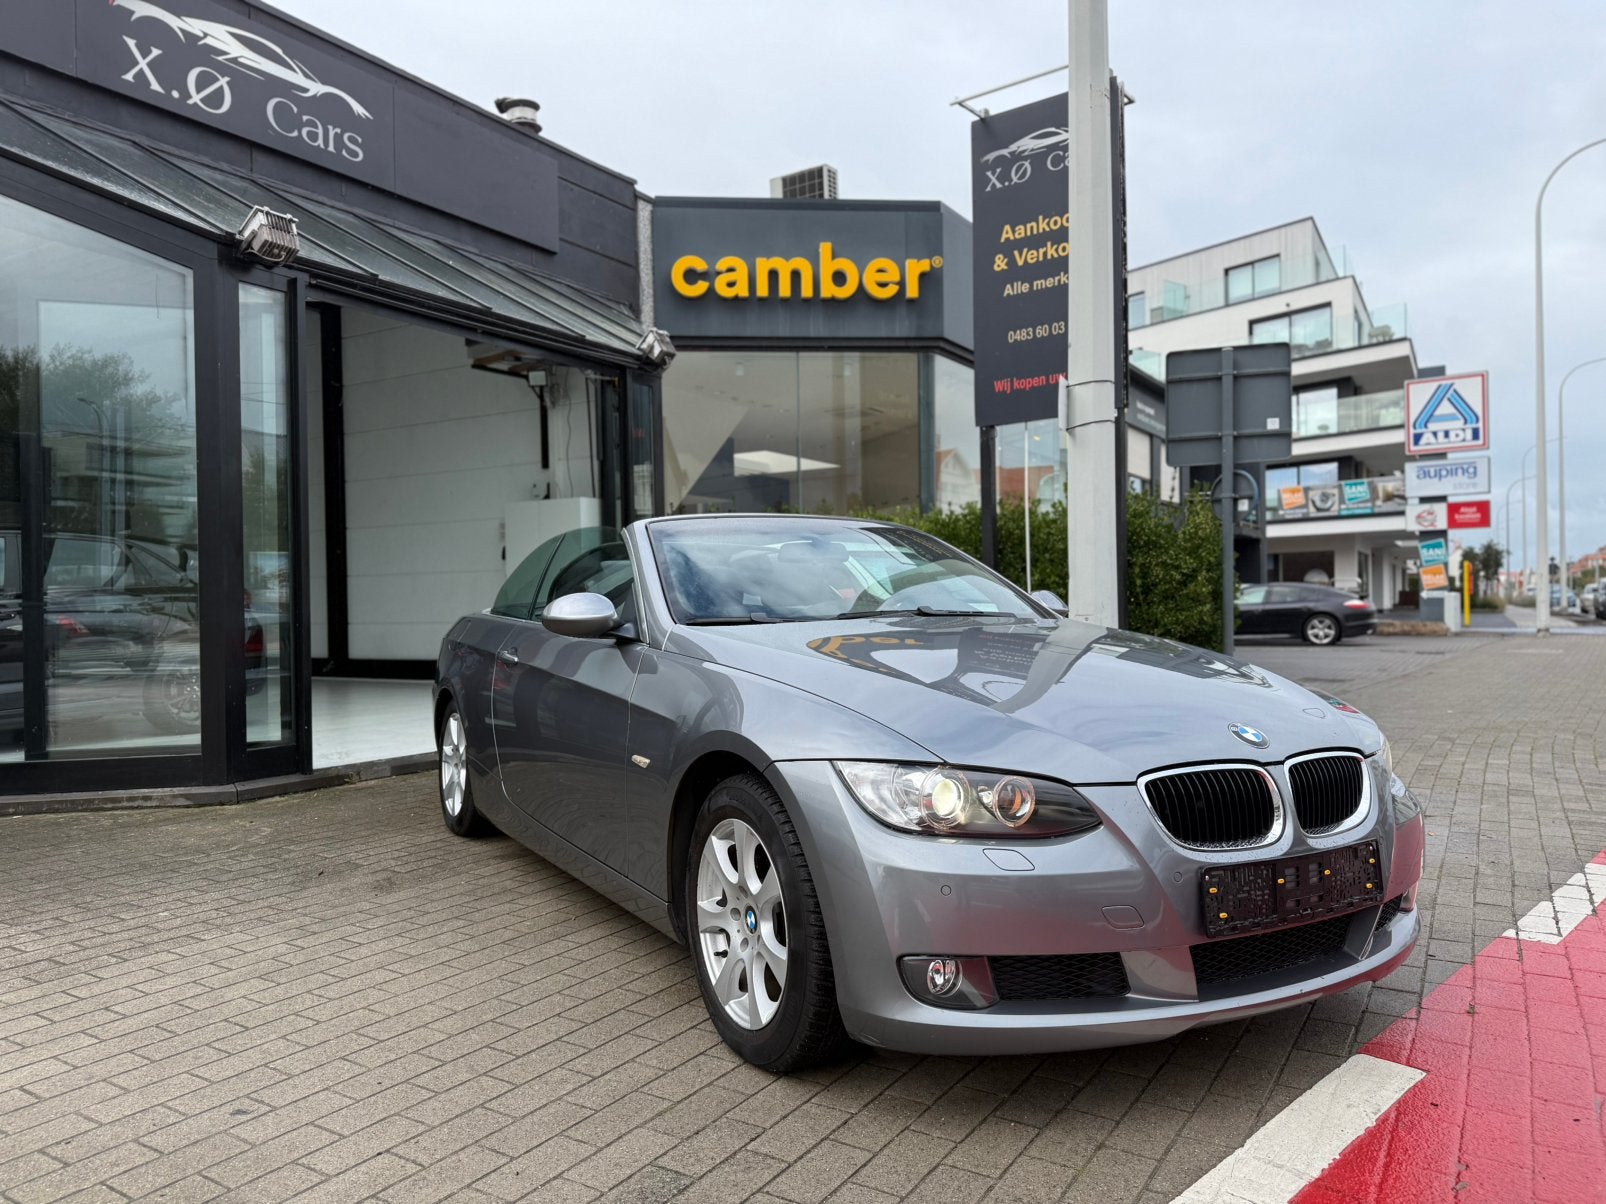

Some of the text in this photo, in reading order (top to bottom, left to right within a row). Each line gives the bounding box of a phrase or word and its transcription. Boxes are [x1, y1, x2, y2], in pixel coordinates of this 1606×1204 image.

[266, 97, 364, 162] Cars
[993, 253, 1008, 271] &
[1003, 280, 1029, 297] Alle
[1008, 321, 1066, 343] 0483 60 03
[994, 378, 1011, 394] Wij
[1013, 374, 1046, 391] kopen
[1418, 427, 1473, 445] ALDI
[1416, 463, 1477, 482] auping
